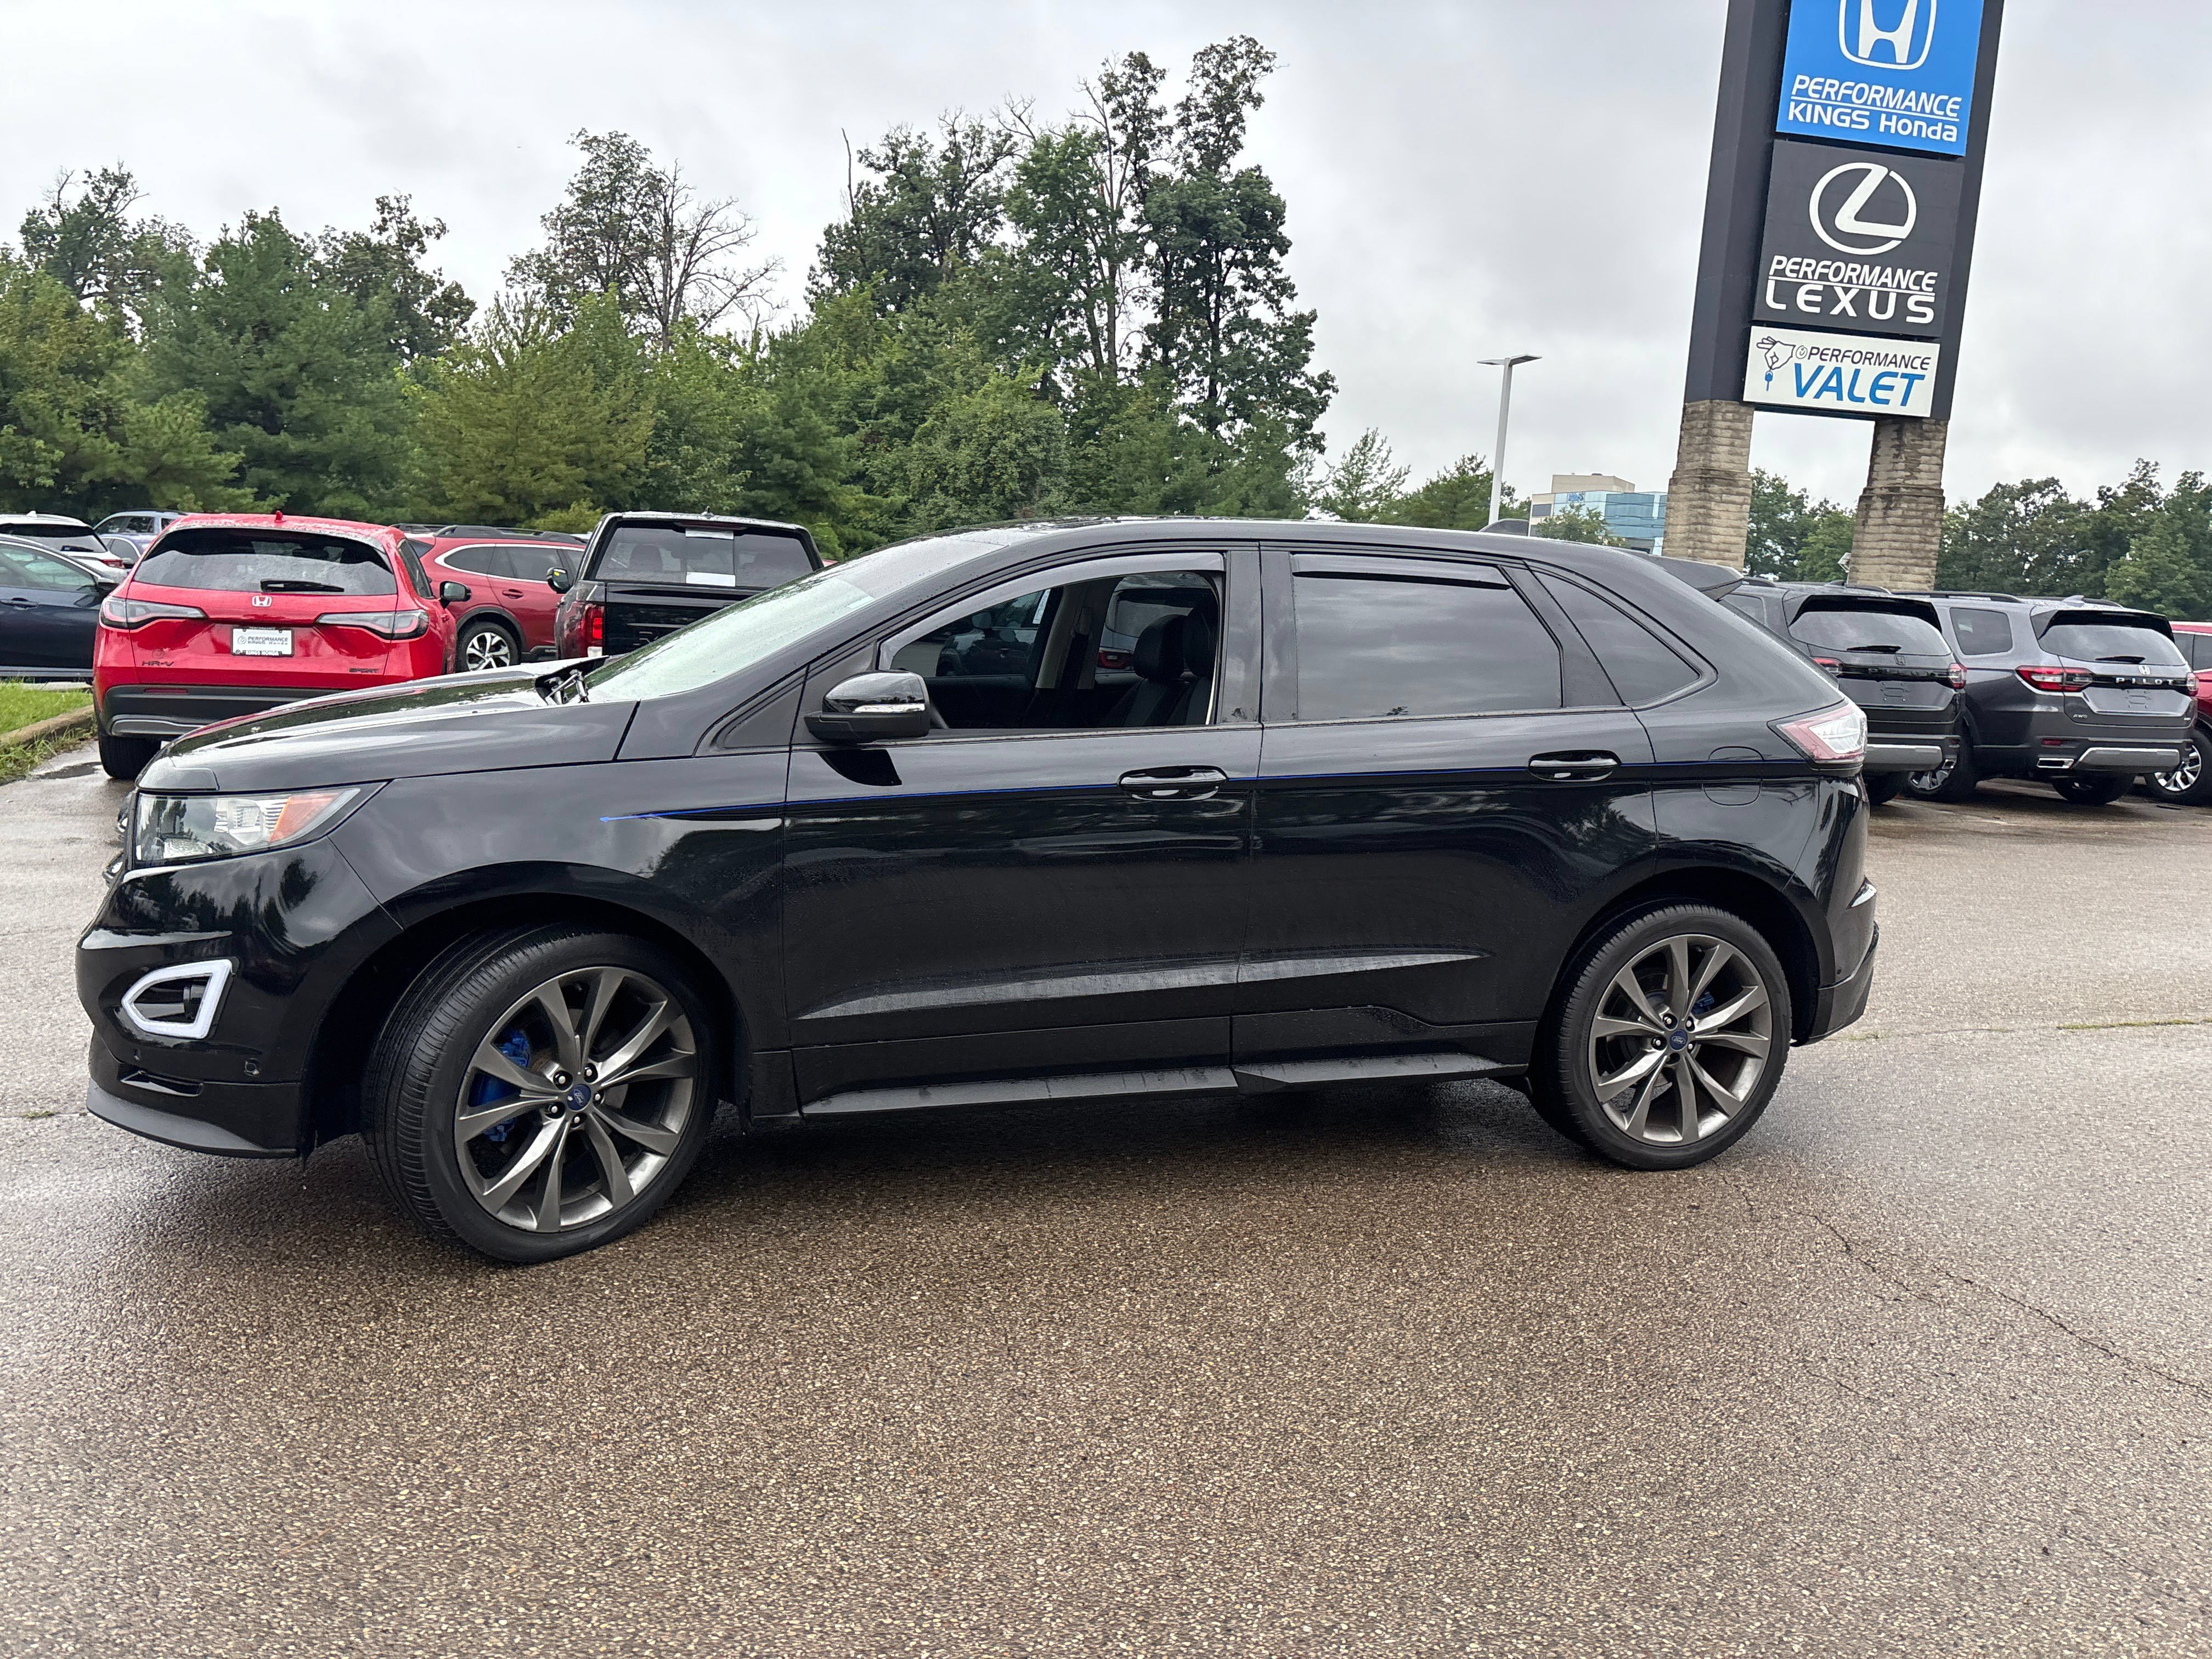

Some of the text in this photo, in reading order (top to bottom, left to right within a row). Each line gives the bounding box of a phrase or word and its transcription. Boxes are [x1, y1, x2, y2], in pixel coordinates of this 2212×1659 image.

[1791, 74, 1962, 117] PERFORMANCE
[1788, 101, 1958, 143] KINGS Honda
[1769, 255, 1938, 292] PERFORMANCE
[1765, 279, 1936, 324] LEXUS
[1807, 346, 1931, 371] PERFORMANCE
[1794, 363, 1926, 407] VALET
[2115, 676, 2174, 686] PILOT
